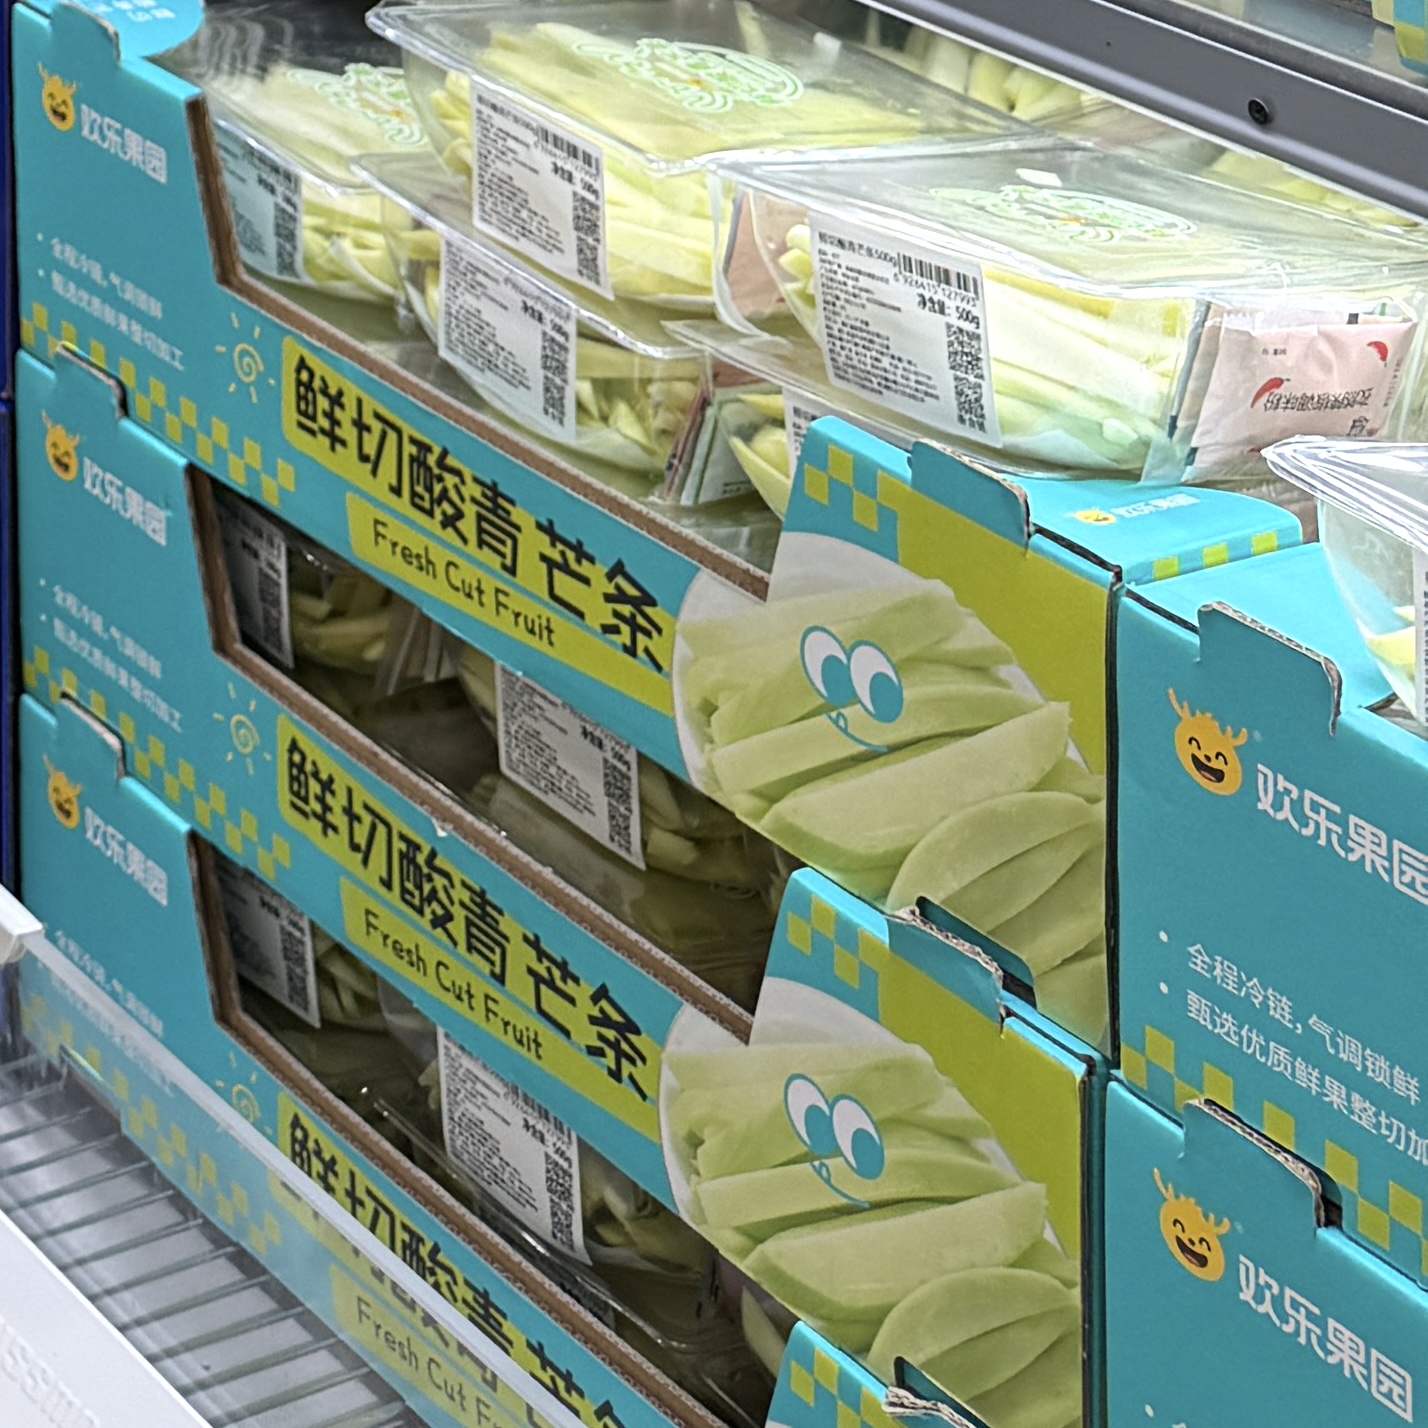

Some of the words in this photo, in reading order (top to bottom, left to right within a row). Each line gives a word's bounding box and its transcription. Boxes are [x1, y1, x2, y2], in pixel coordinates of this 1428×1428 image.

[955, 305, 980, 330] 500g
[294, 354, 665, 672] 鲜切酸青芒条
[370, 517, 438, 579] Fresh
[443, 555, 487, 606] Cut
[493, 586, 557, 651] Fruit
[1256, 763, 1428, 906] 欢乐果园
[286, 734, 648, 1103] 鲜切酸青芒条
[362, 909, 431, 979] Fresh
[434, 951, 477, 1004] Cut
[483, 986, 547, 1063] Fruit
[1187, 942, 1422, 1107] 全程冷链,气调锁鲜
[356, 1296, 419, 1373] Fresh
[427, 1359, 468, 1420] Cut
[1239, 1252, 1415, 1423] 欢乐果园
